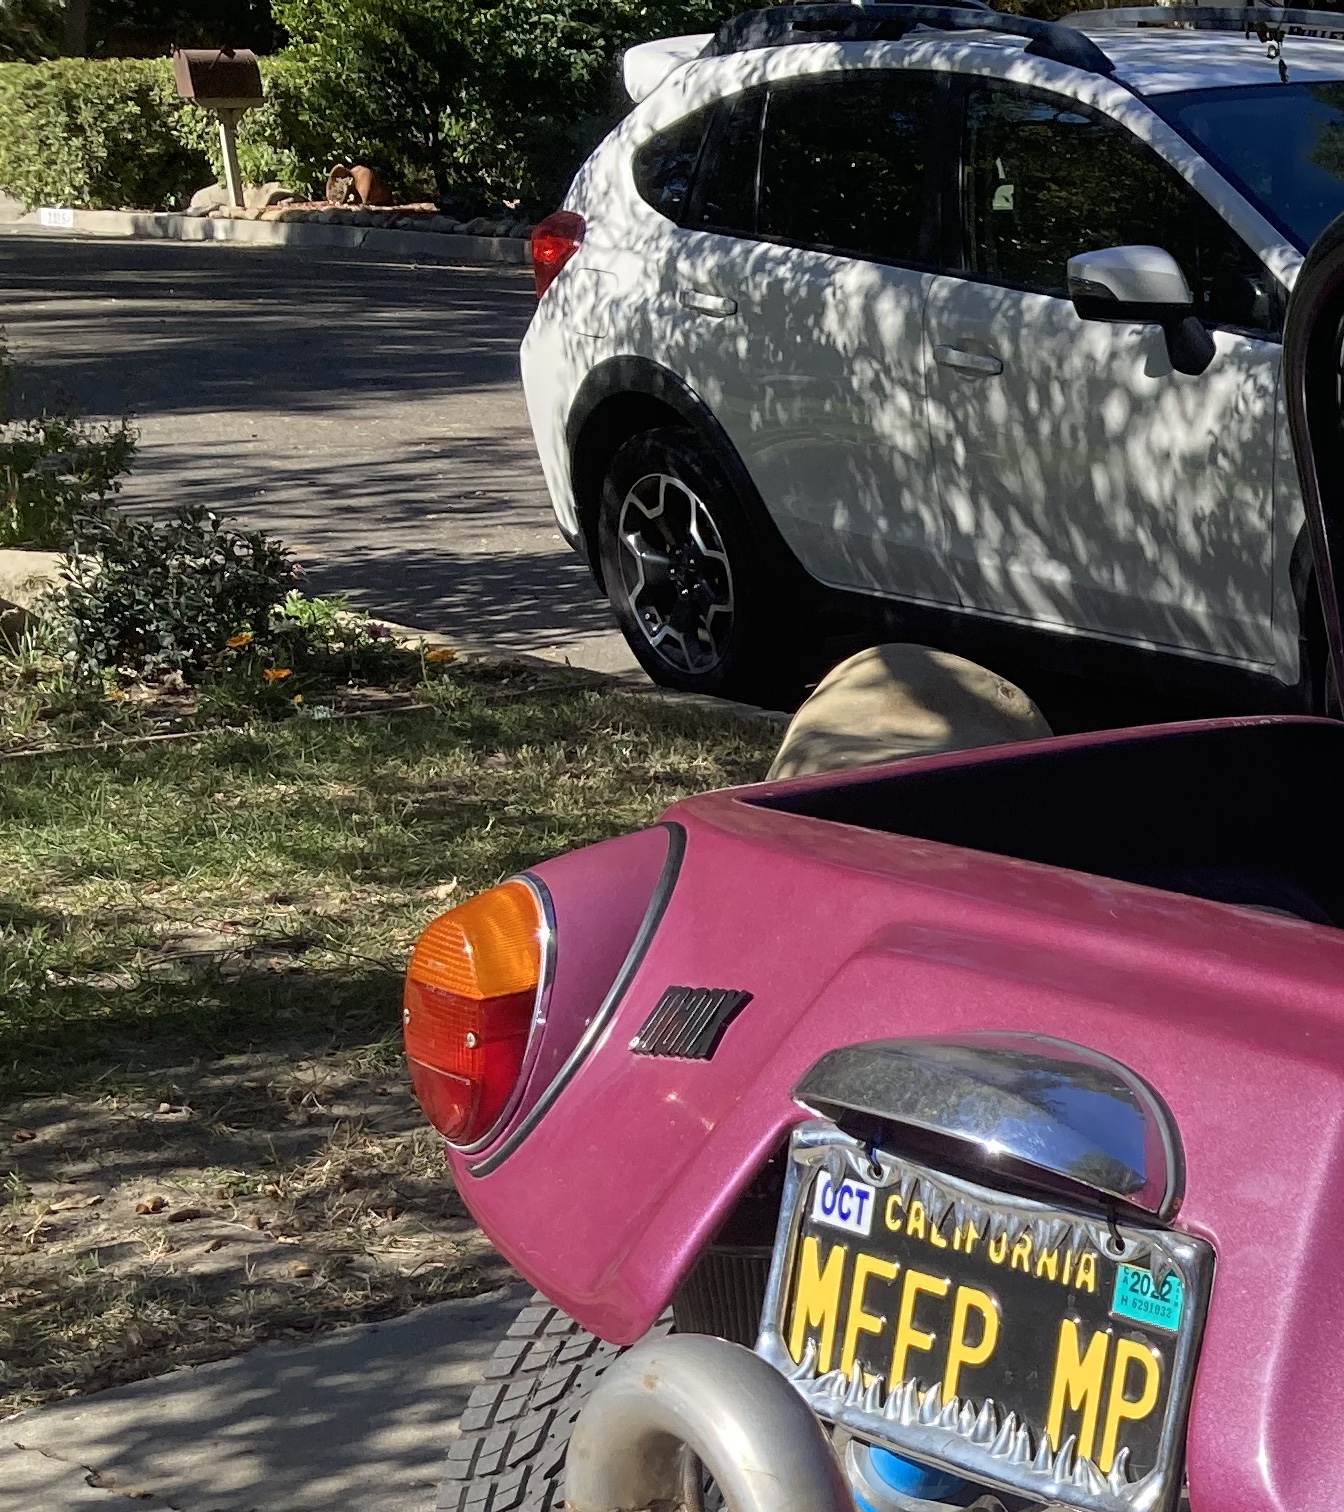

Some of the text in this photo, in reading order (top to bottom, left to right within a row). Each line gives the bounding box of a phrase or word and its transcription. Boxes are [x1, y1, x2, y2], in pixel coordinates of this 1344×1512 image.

[819, 1179, 871, 1226] OCT
[1132, 1298, 1172, 1319] 6291032
[1046, 1317, 1161, 1474] MP
